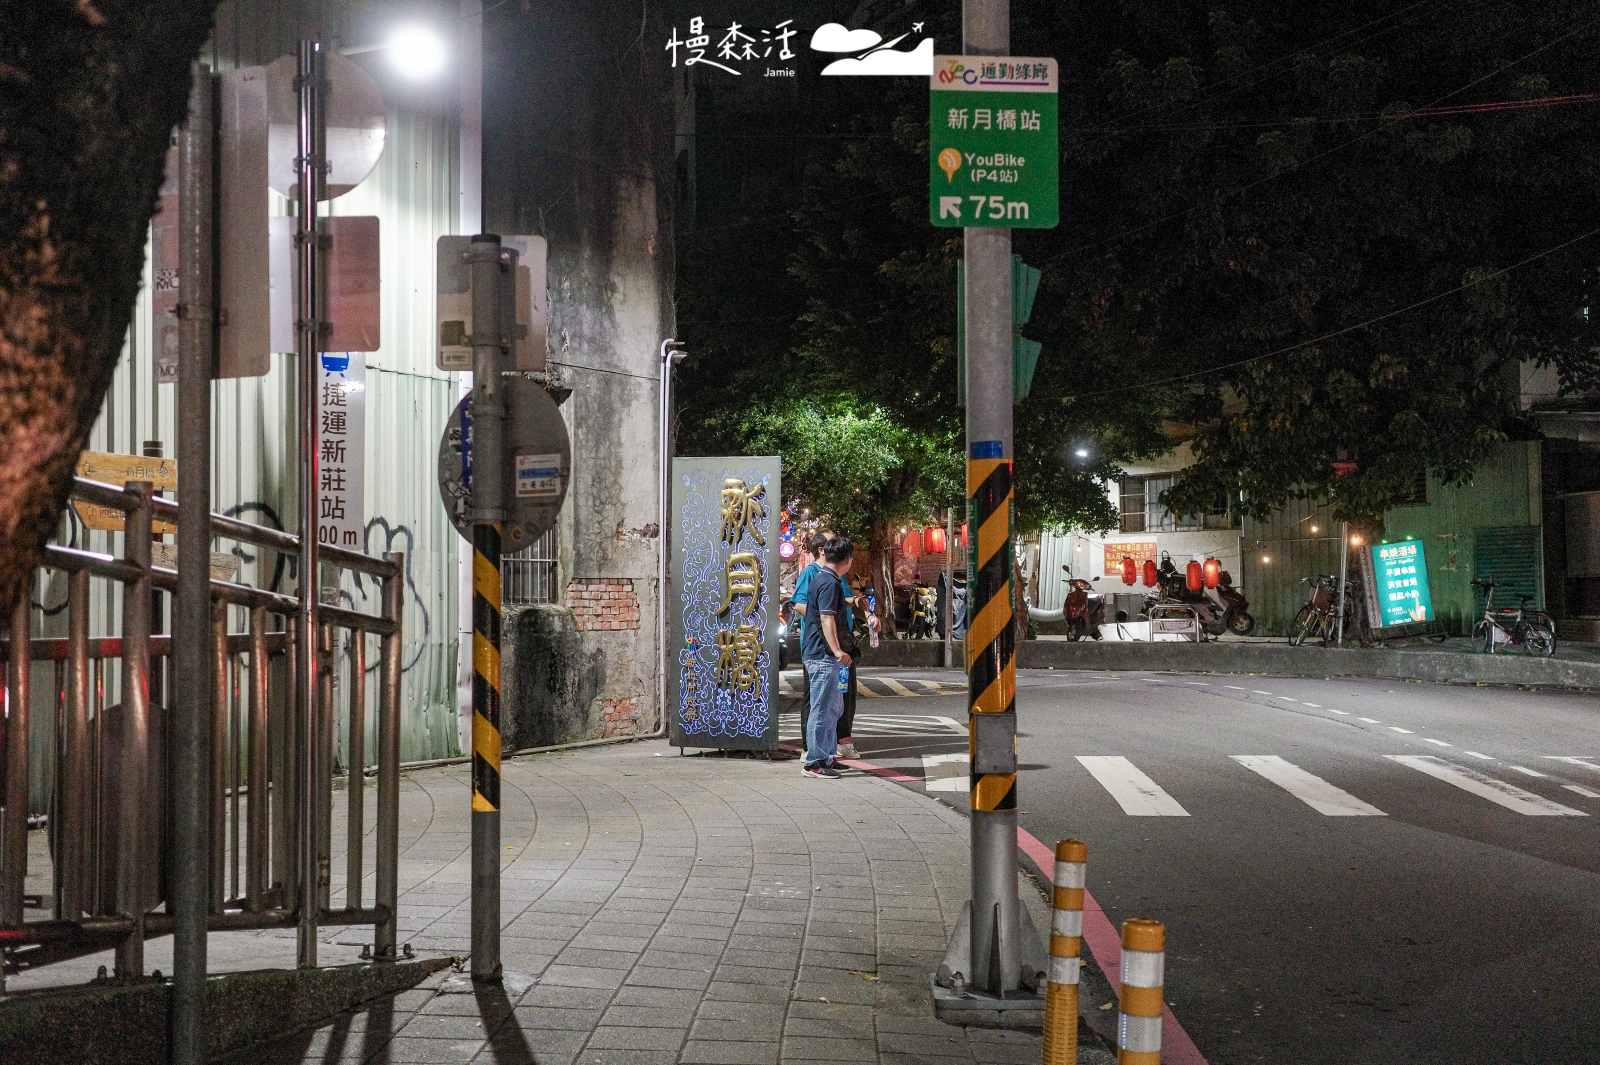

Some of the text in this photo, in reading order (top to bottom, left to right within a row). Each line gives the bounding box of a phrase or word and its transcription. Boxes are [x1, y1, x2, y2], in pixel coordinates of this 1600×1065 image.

[980, 61, 1049, 81] 通勤綠廊
[947, 108, 1041, 131] 新月橋站
[964, 152, 1025, 167] YouBike
[970, 169, 1019, 183] (P4站)
[969, 195, 1029, 219] 75m
[320, 382, 348, 520] 捷運新莊站
[343, 529, 357, 545] m
